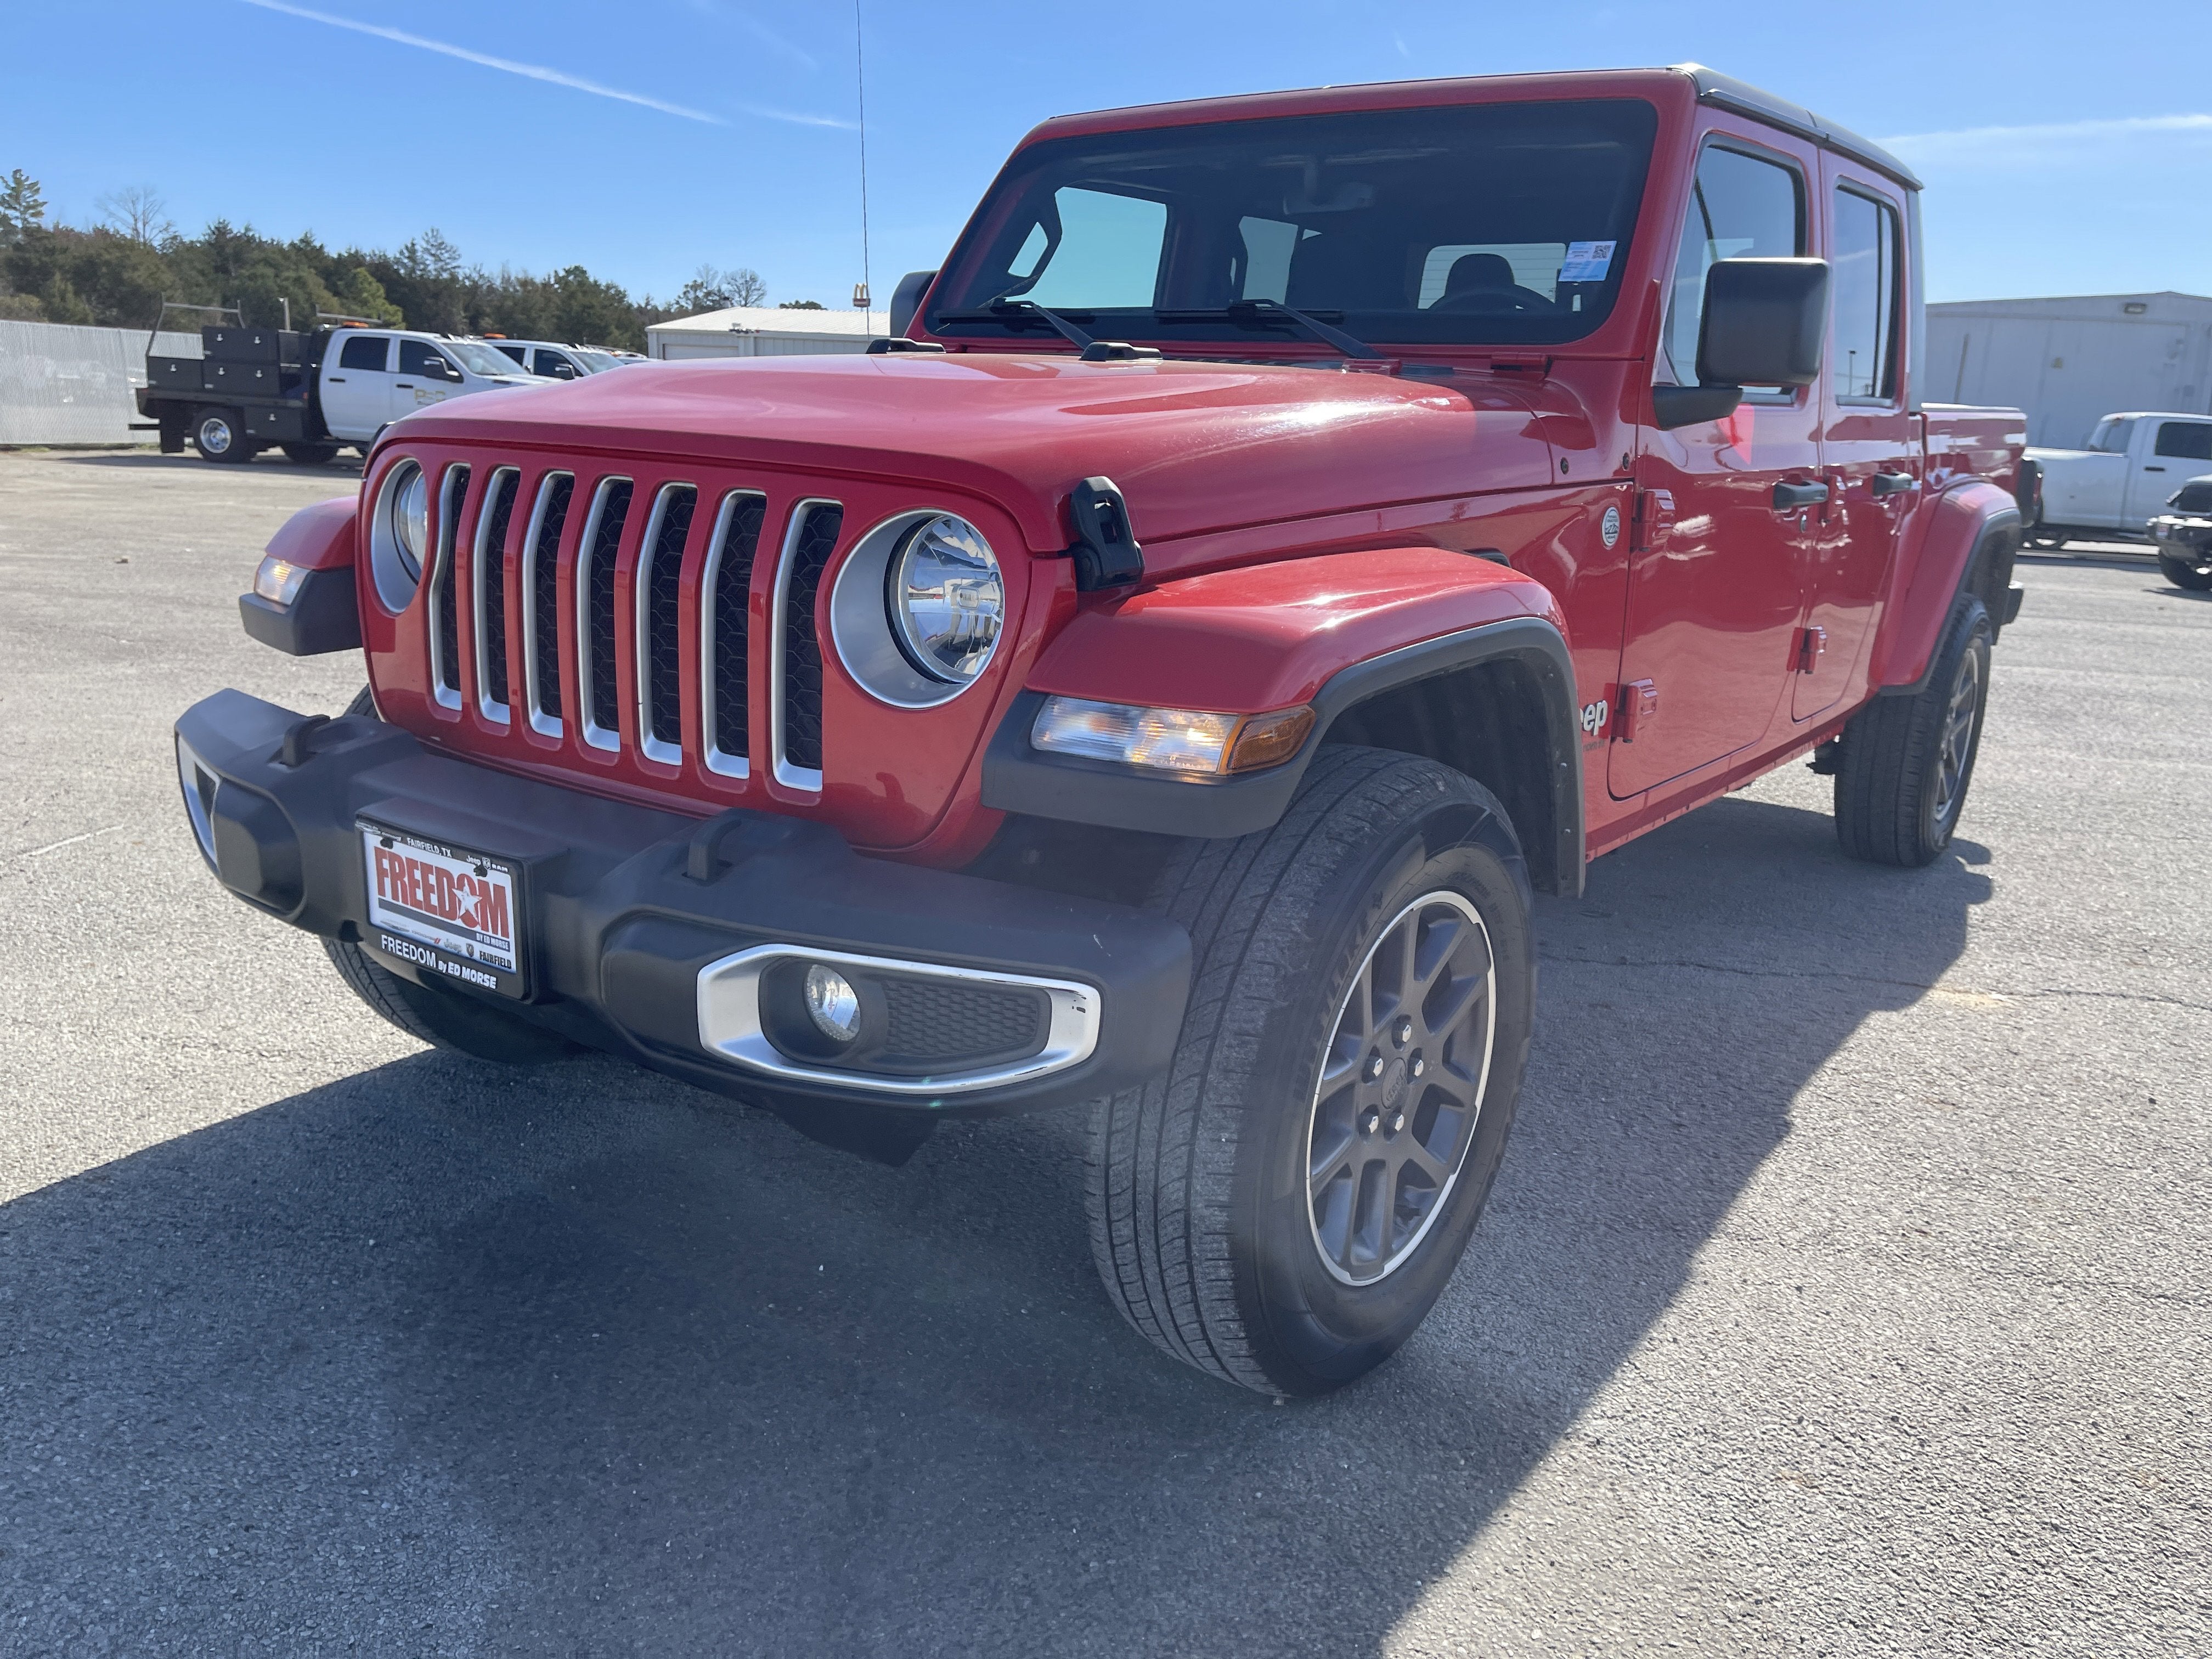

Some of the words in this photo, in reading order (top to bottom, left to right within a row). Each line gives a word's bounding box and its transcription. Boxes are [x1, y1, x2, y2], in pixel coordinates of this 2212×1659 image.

[374, 845, 509, 939] FREEDOM
[381, 934, 436, 968] FREEDOM
[448, 961, 461, 976] ED
[461, 966, 496, 989] MORSE
[479, 950, 512, 969] FAIRFIELD
